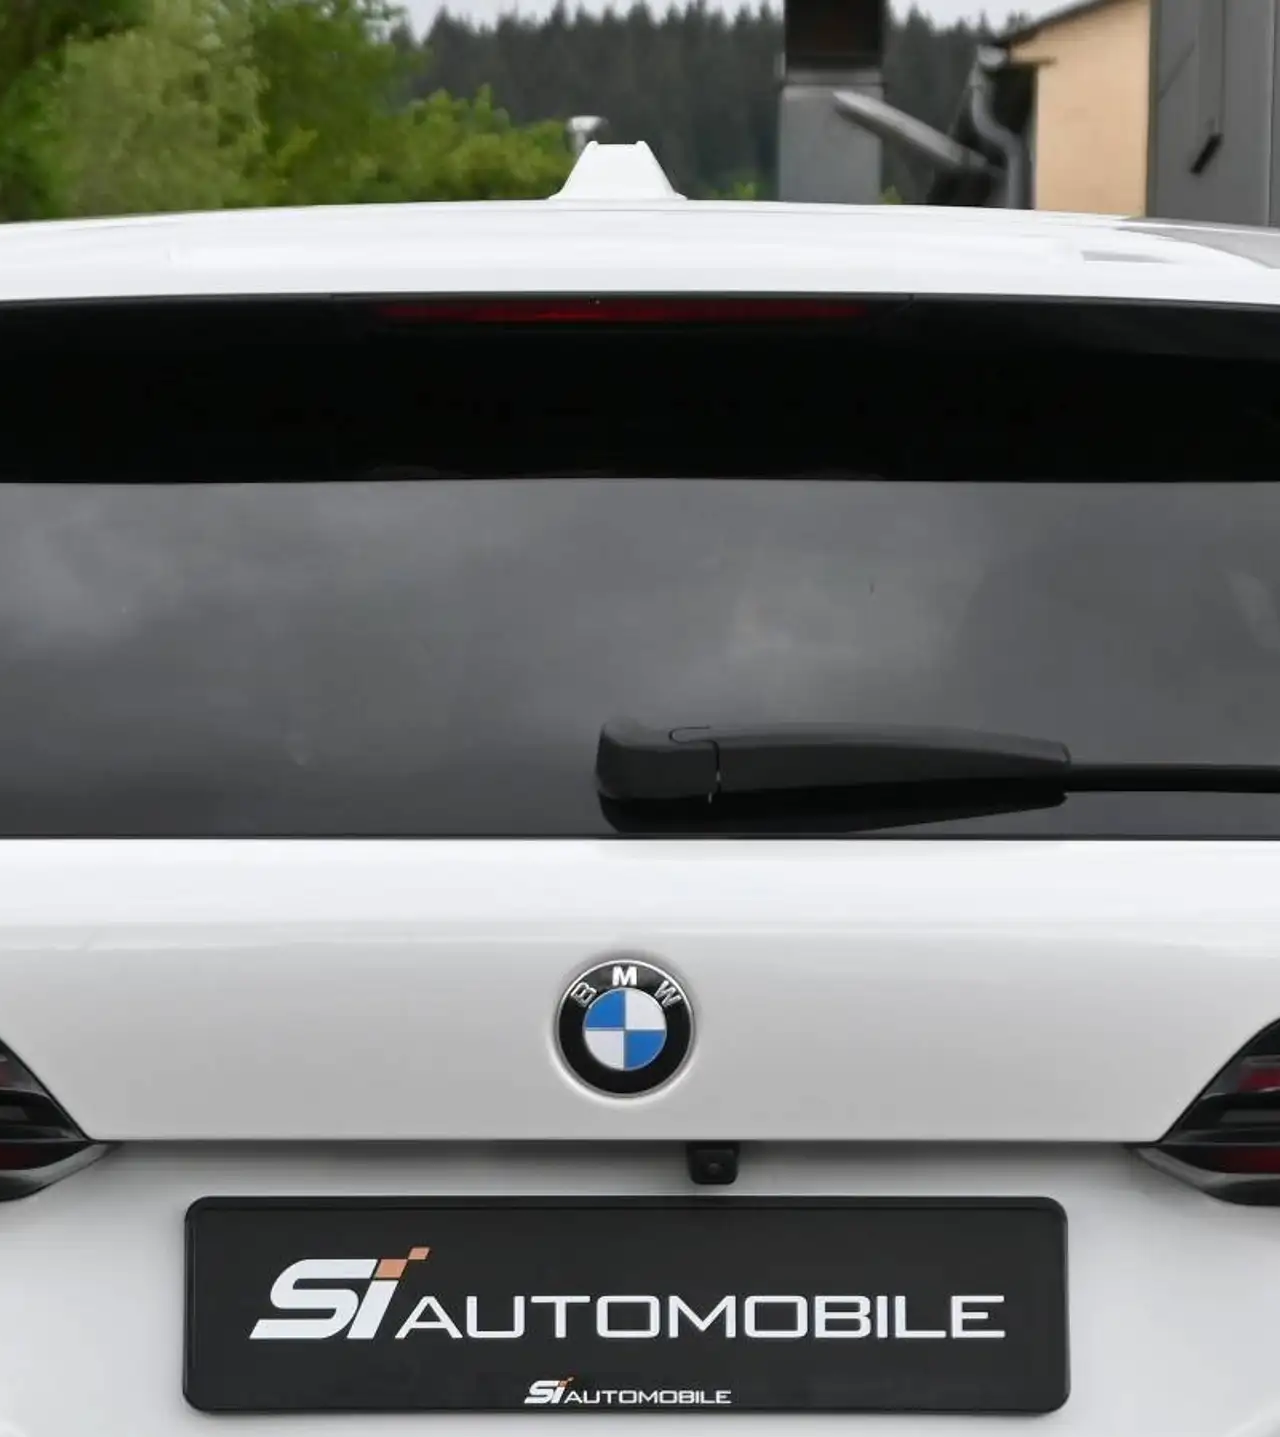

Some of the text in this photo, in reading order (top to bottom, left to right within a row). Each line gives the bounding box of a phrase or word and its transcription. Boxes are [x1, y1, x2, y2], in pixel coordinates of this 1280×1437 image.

[570, 966, 682, 1008] BMW
[394, 1295, 1006, 1339] AUTOMOBILE
[563, 1390, 732, 1404] AUTOMOBILE
